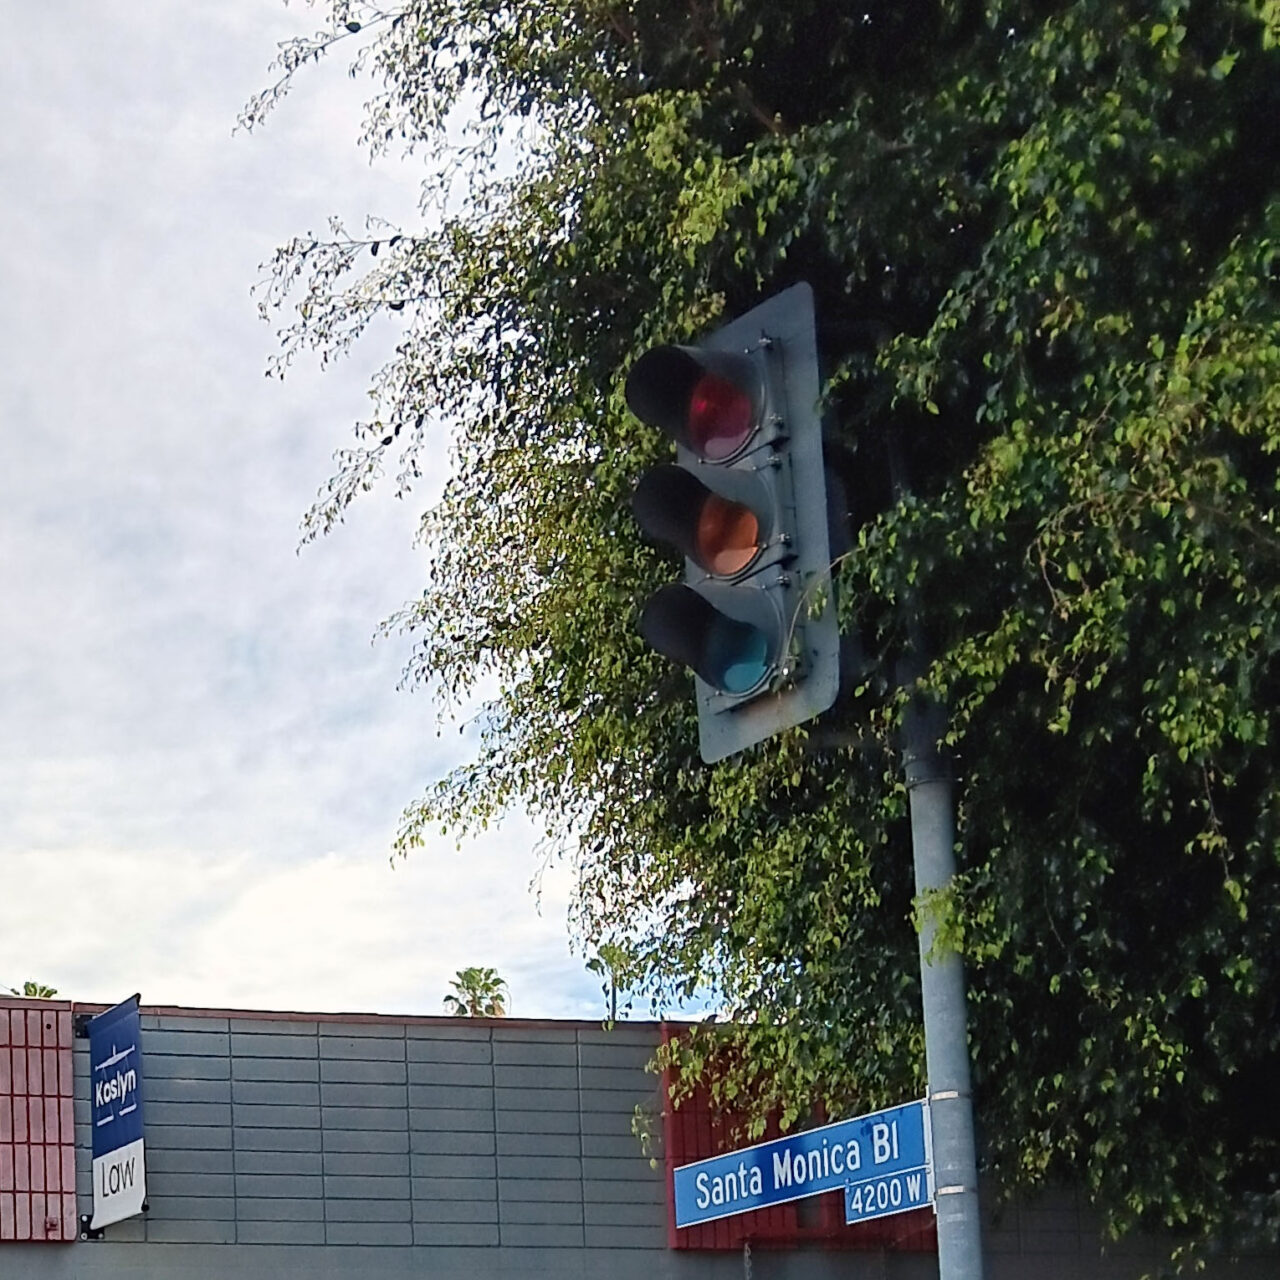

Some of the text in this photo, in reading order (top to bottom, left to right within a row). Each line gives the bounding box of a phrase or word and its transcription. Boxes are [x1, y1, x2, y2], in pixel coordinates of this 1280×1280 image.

[95, 1069, 136, 1107] Koslyn
[102, 1157, 135, 1198] Law
[695, 1120, 899, 1209] Santa Monica Bl
[851, 1174, 921, 1215] 4200 W
